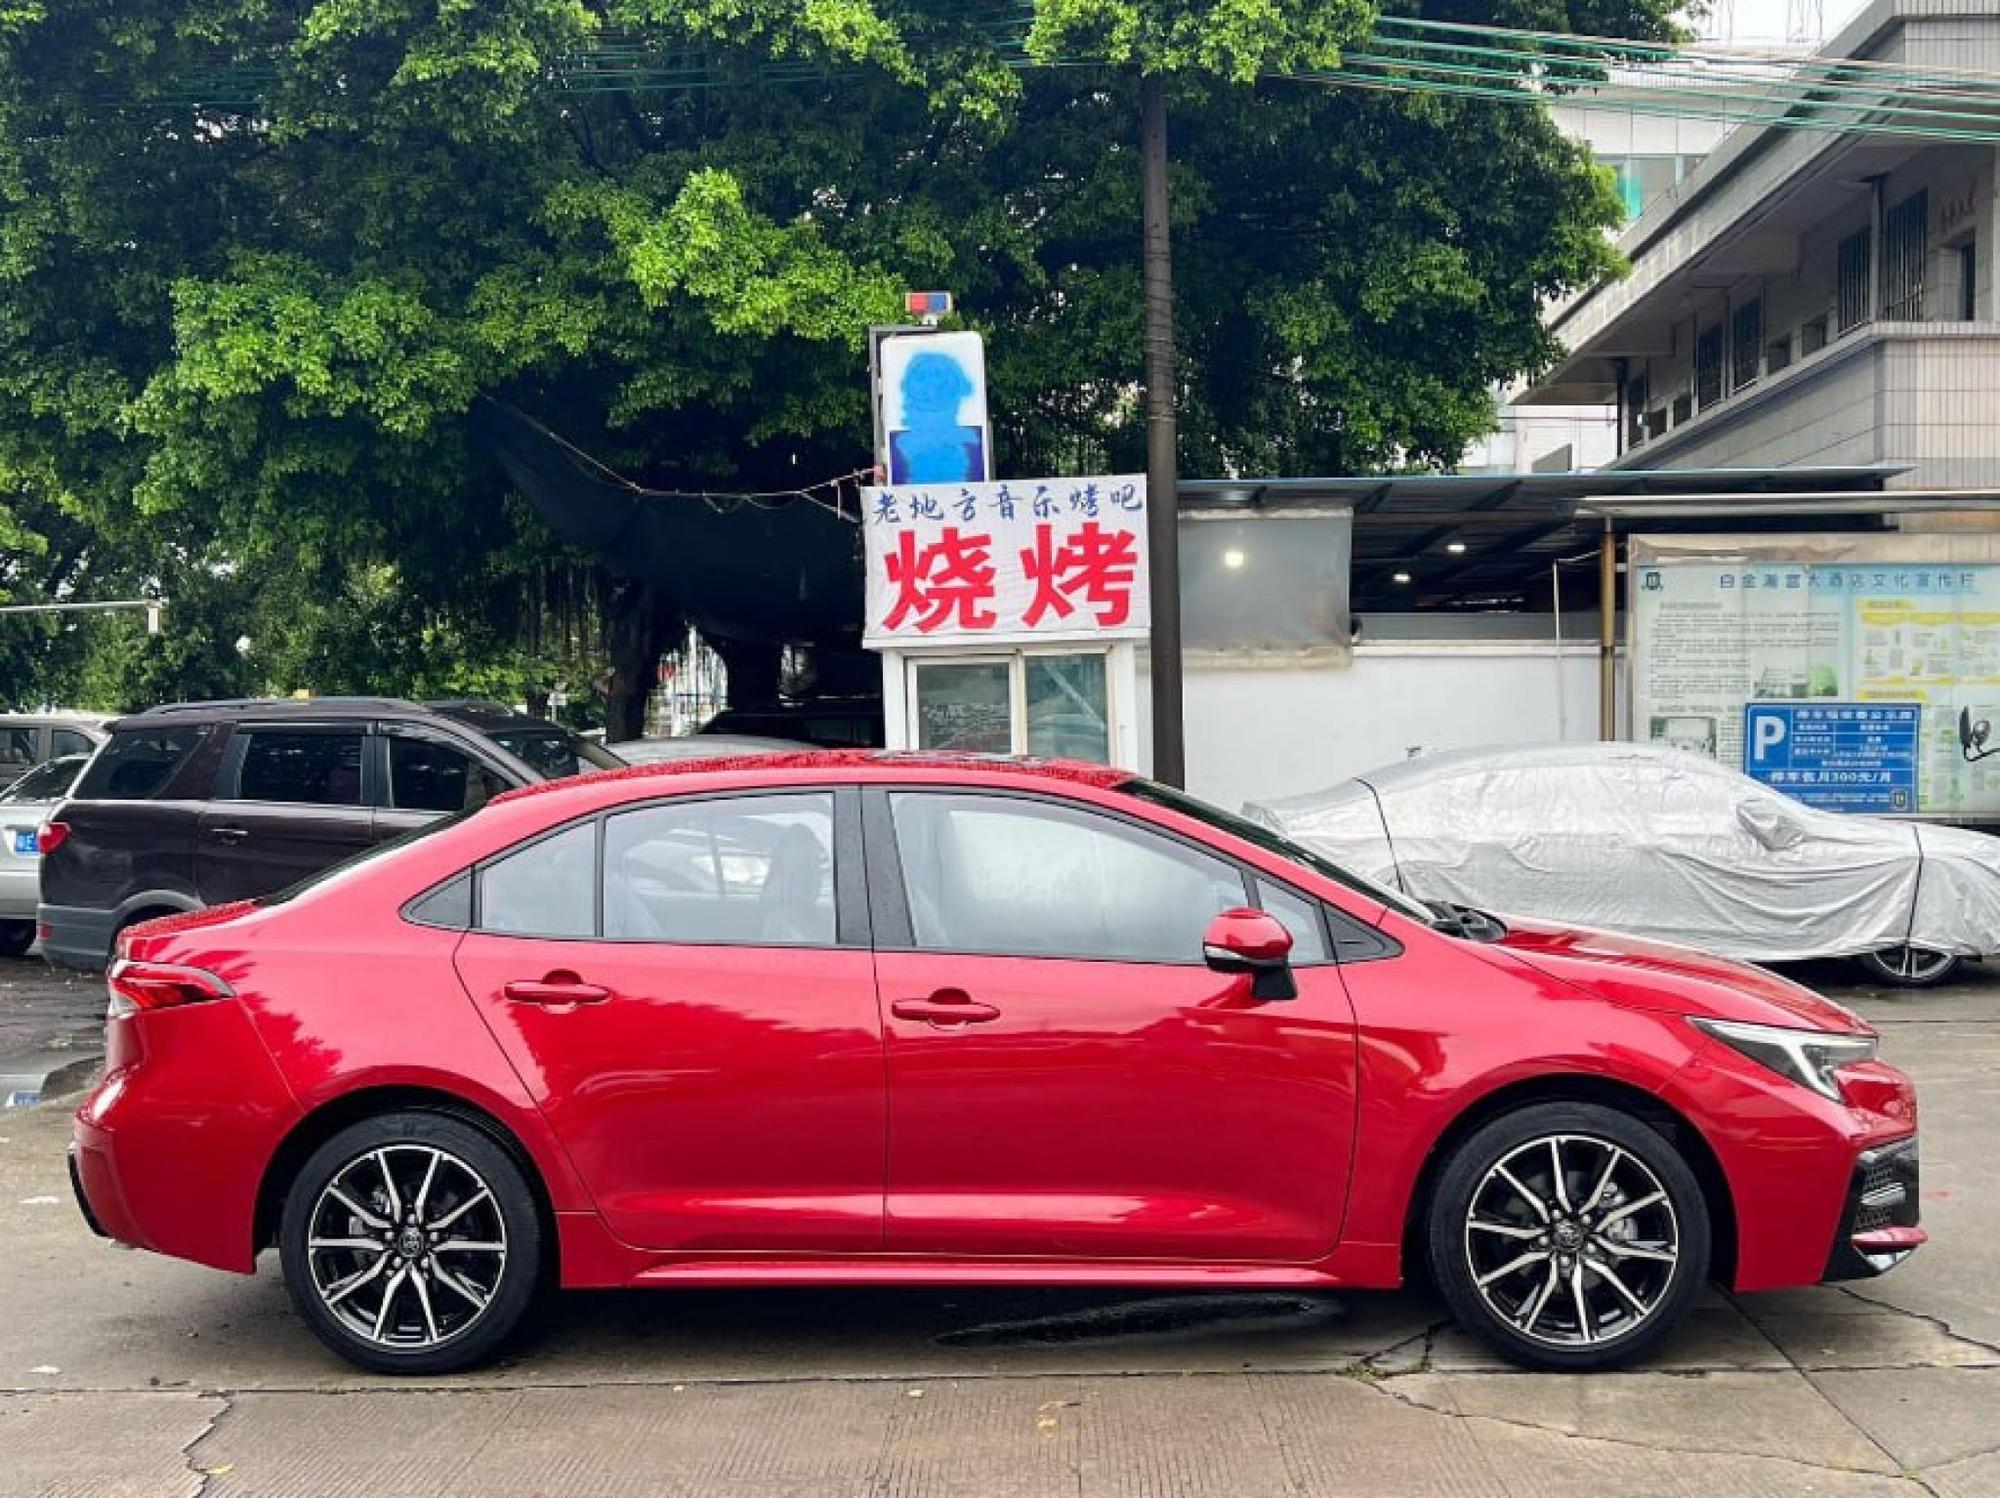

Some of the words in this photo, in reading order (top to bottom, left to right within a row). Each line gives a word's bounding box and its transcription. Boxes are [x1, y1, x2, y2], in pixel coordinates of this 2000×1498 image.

[872, 482, 1143, 525] 老地方音乐烤吧
[882, 520, 1139, 633] 烧烤
[1754, 715, 1787, 761] P
